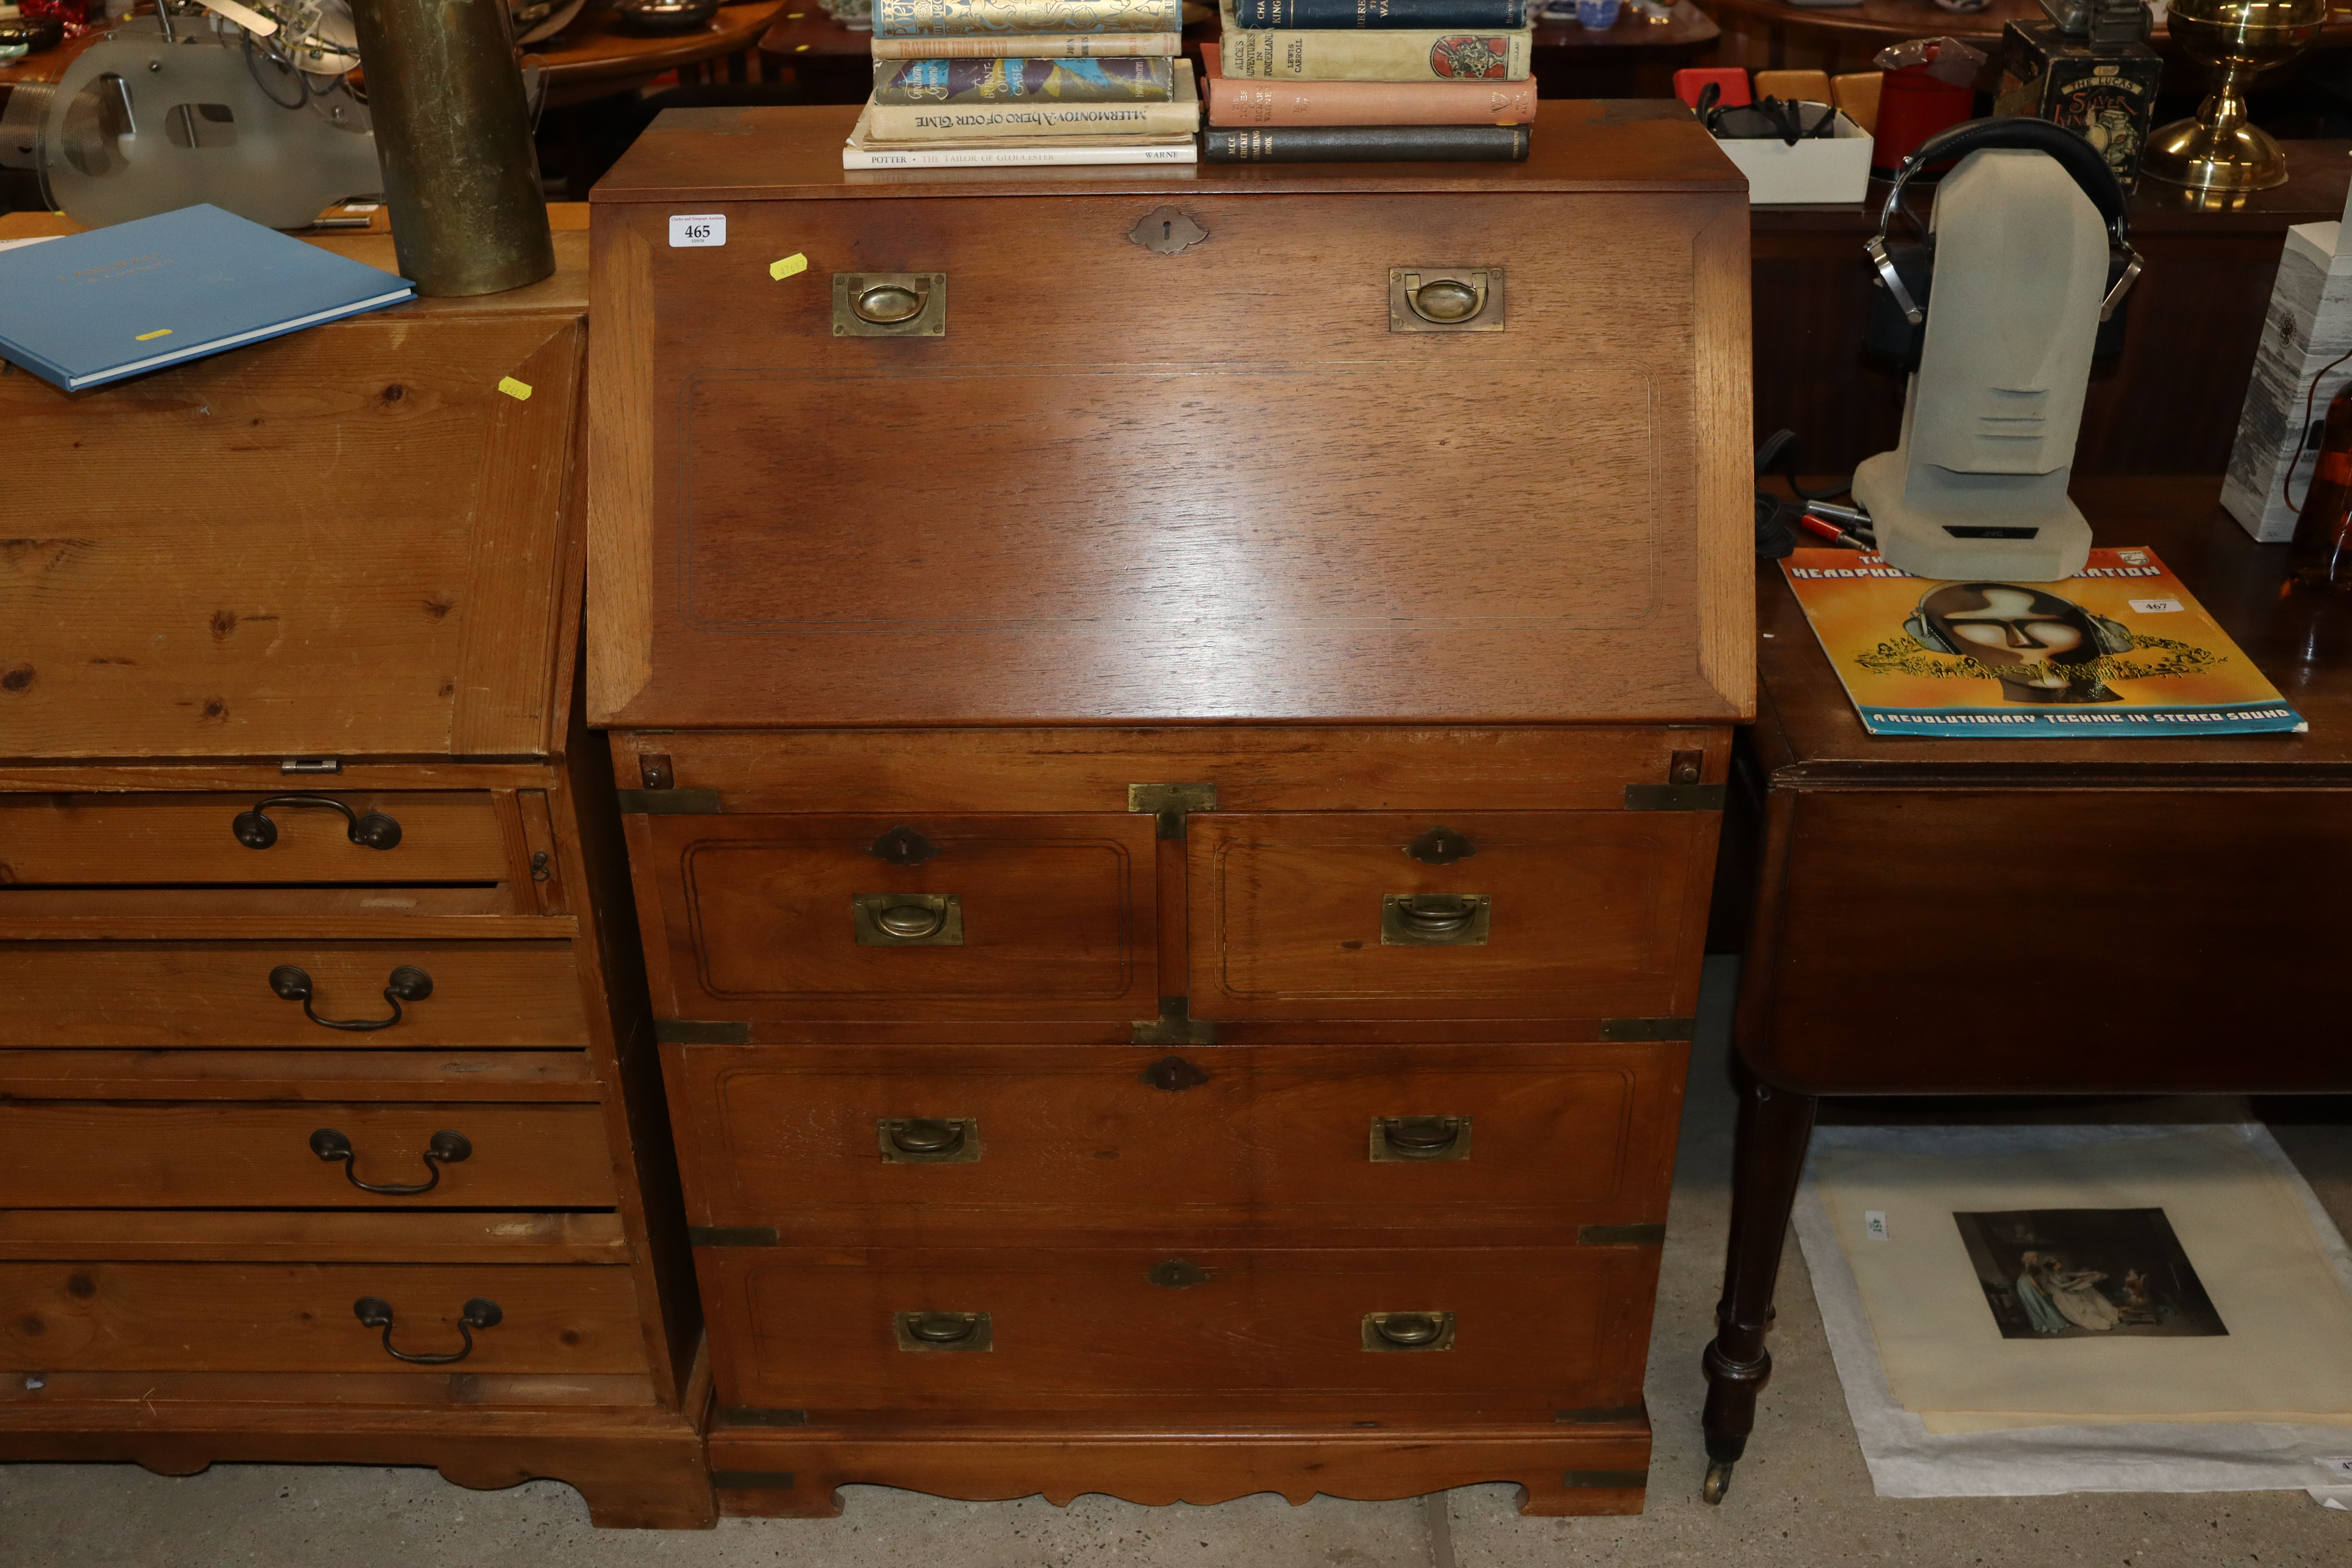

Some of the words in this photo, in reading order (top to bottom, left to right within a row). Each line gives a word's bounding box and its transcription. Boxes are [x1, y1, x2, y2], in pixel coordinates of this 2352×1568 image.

[1272, 0, 1281, 23] KING
[1357, 0, 1366, 28] HERE
[1380, 0, 1388, 18] WA
[899, 41, 949, 57] TRAVELLER
[952, 41, 975, 56] FROM
[978, 40, 1007, 56] TOKYO
[1247, 34, 1255, 78] ADVENTURES
[1257, 52, 1262, 61] IN
[906, 66, 922, 99] Graham
[924, 66, 948, 100] Greene
[971, 78, 981, 89] A
[984, 62, 995, 98] BURNT-
[998, 67, 1009, 93] OUT
[1013, 65, 1024, 96] CASE
[1135, 62, 1144, 98] Heinemann
[2071, 79, 2092, 89] THE
[2099, 78, 2134, 90] LUCAS
[1264, 84, 1272, 122] WAGNER
[915, 116, 954, 128] TIME
[956, 115, 985, 126] OUR
[986, 113, 1003, 125] OF
[997, 154, 1054, 162] GLOUCESTER
[685, 225, 710, 238] 465
[780, 259, 804, 275] 47697
[504, 385, 528, 399] 24514
[1858, 556, 1885, 565] TH
[1873, 714, 1885, 722] A
[1887, 714, 2036, 724] REVOLUTIONARY
[2044, 714, 2123, 724] TECHNIC
[2126, 714, 2149, 722] IN
[2153, 713, 2225, 722] STEREO
[2226, 709, 2291, 721] SOUND
